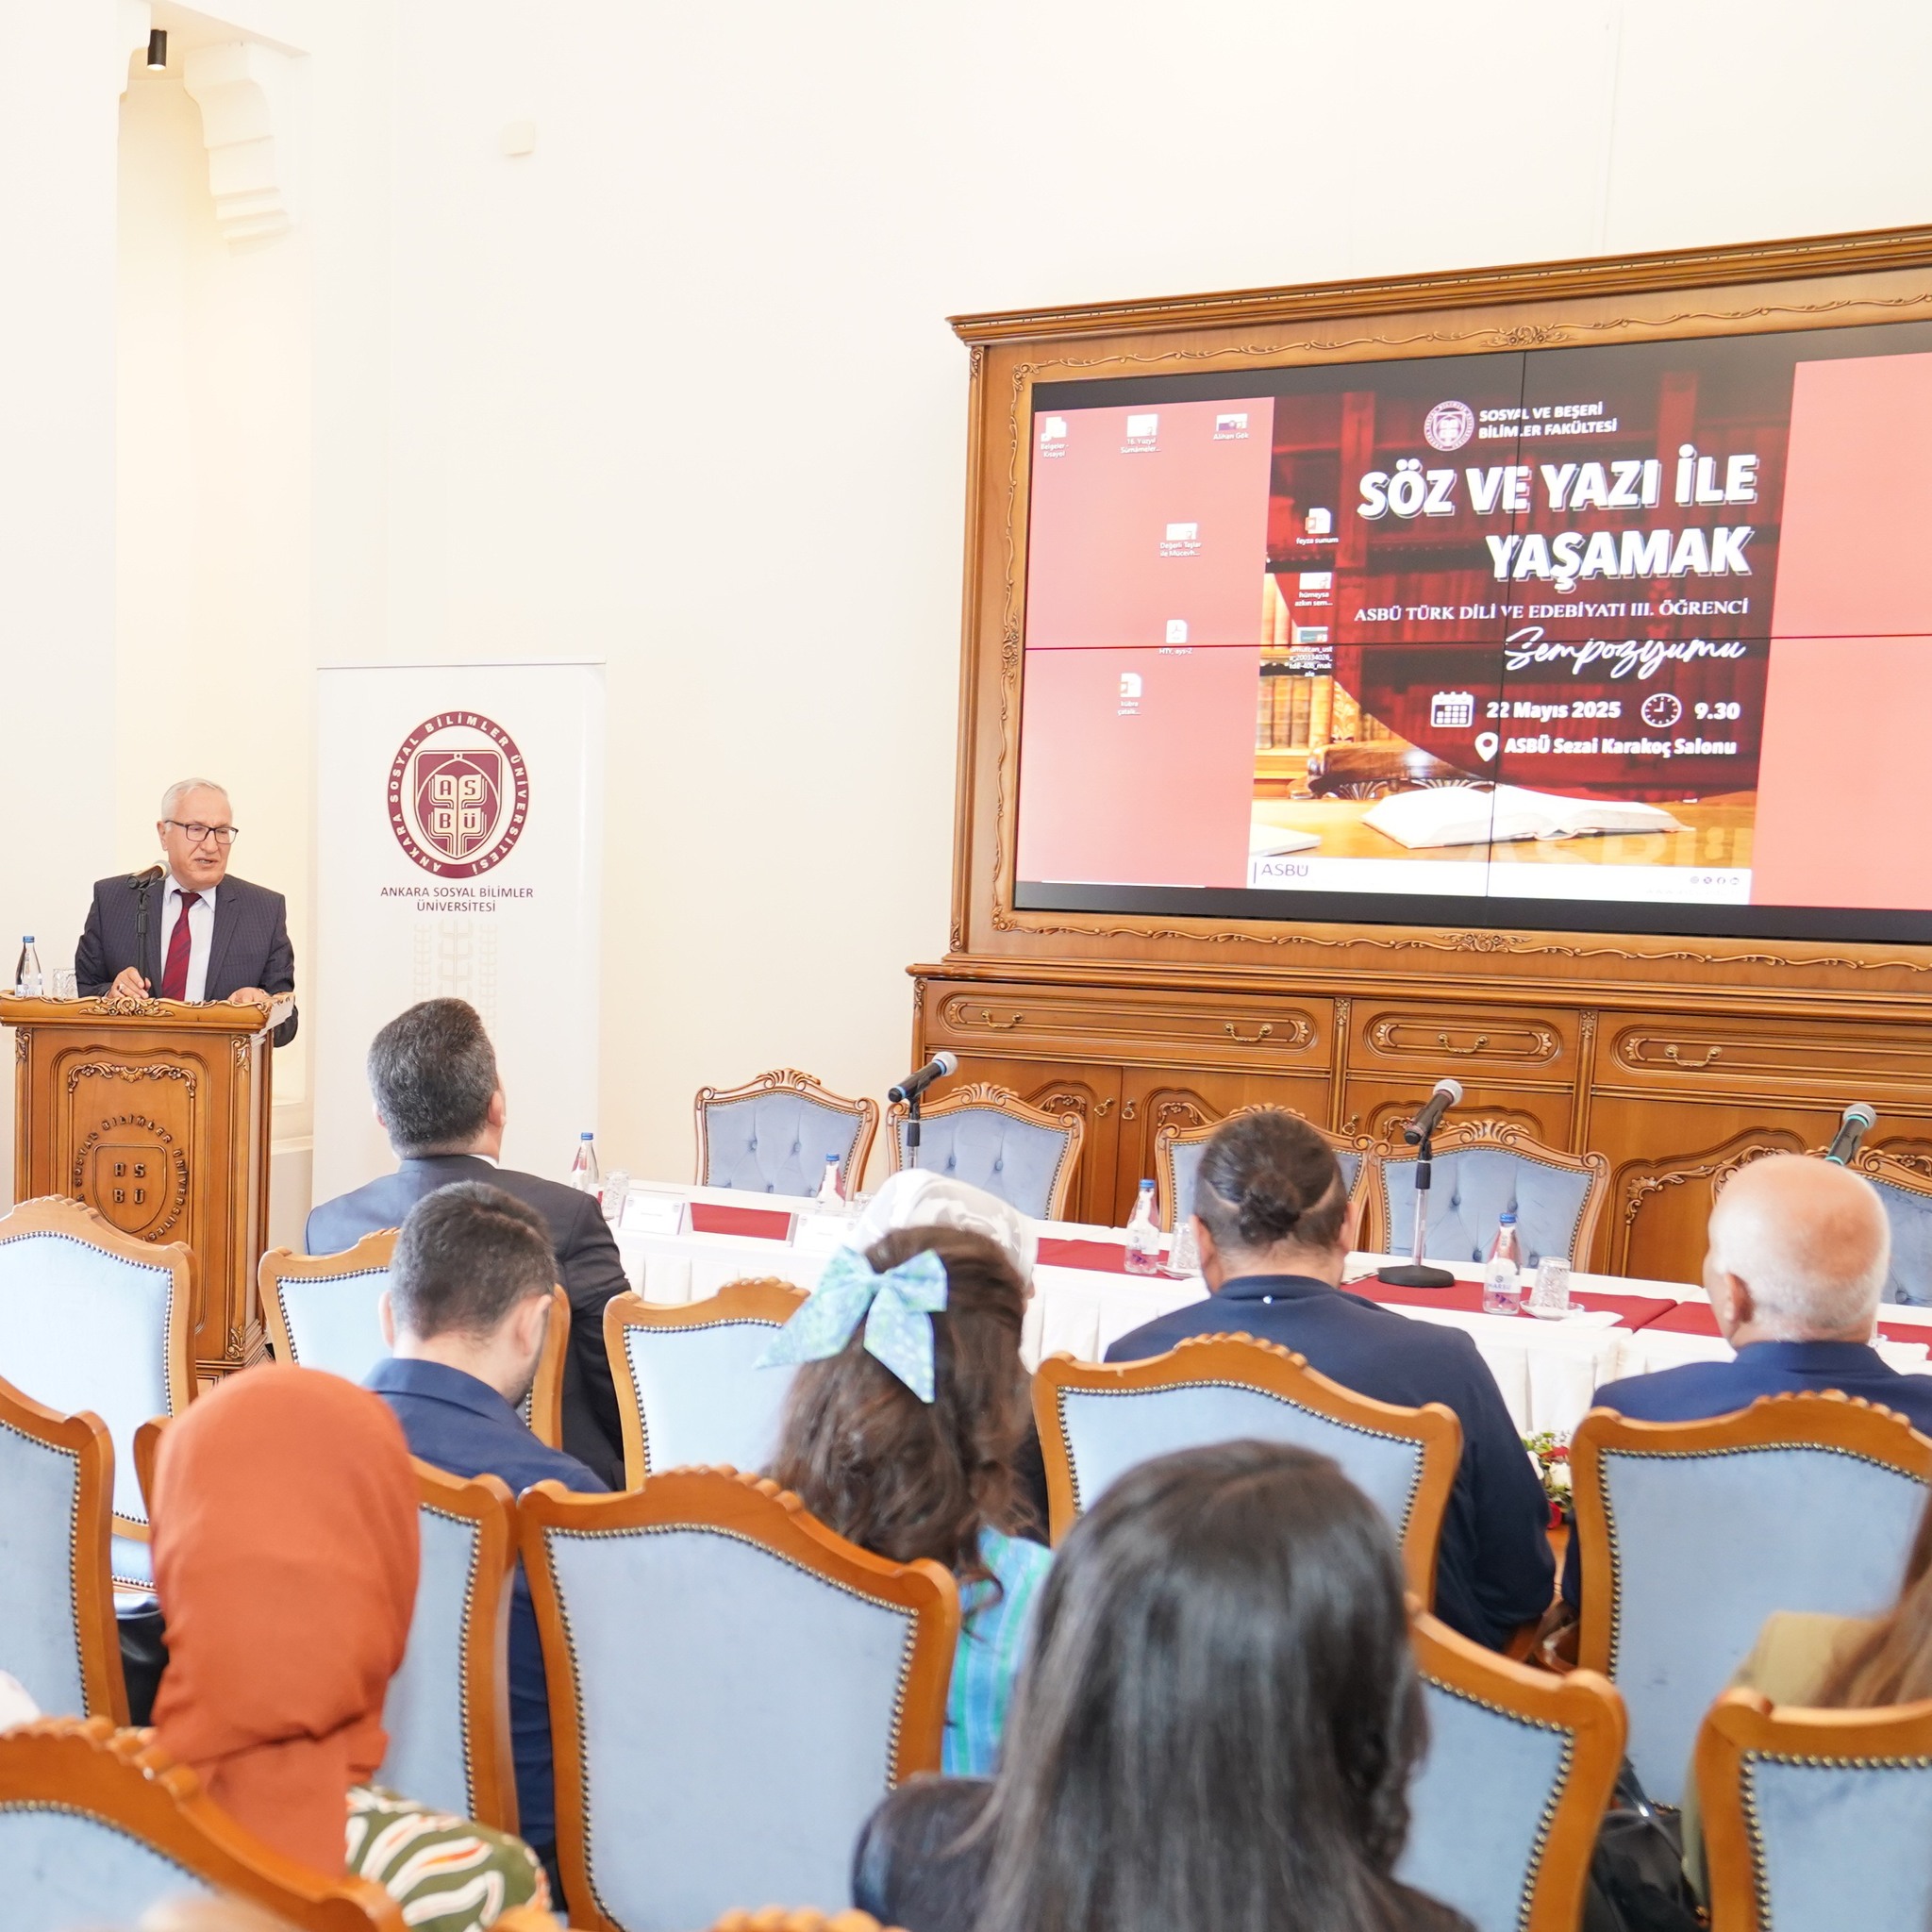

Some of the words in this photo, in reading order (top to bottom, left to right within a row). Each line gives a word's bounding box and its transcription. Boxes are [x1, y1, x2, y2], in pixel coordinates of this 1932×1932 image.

[1479, 407, 1528, 422] SOSYAL
[1532, 406, 1550, 420] VE
[1553, 401, 1603, 421] BEŞERİ
[1545, 417, 1617, 436] FAKÜLTESİ
[1357, 458, 1457, 520] SÖZ
[1466, 465, 1534, 513] VE
[1541, 458, 1662, 510] YAZI
[1674, 443, 1759, 506] İLE
[1486, 526, 1755, 592] YAŞAMAK
[1354, 604, 1401, 623] ASBÜ
[1406, 602, 1455, 621] TÜRK
[1458, 601, 1496, 620] DİLİ
[1500, 604, 1524, 619] VE
[1528, 600, 1624, 619] EDEBİYATI
[1630, 600, 1655, 618] III.
[1658, 597, 1748, 618] ÖĞRENCİ
[1504, 626, 1746, 680] Sempozyumu
[1487, 702, 1508, 719] 22
[1513, 701, 1569, 723] Mayıs
[1573, 701, 1621, 719] 2025
[1694, 702, 1741, 721] 9.30
[425, 712, 509, 747] BİLİMLER
[1504, 735, 1550, 755] ASBÜ
[1553, 737, 1598, 755] Sezai
[1602, 737, 1671, 759] Karakoç
[1674, 737, 1736, 755] Salonu
[389, 737, 420, 804] SOSYAL
[472, 754, 528, 875] ÜNİVERSİTESİ
[393, 814, 441, 873] ANKARA
[1261, 862, 1308, 877] ASBÜ
[381, 887, 429, 898] ANKARA
[434, 887, 477, 898] SOSYAL
[479, 885, 534, 898] BİLİMLER
[417, 899, 496, 912] ÜNİVERSİTESİ
